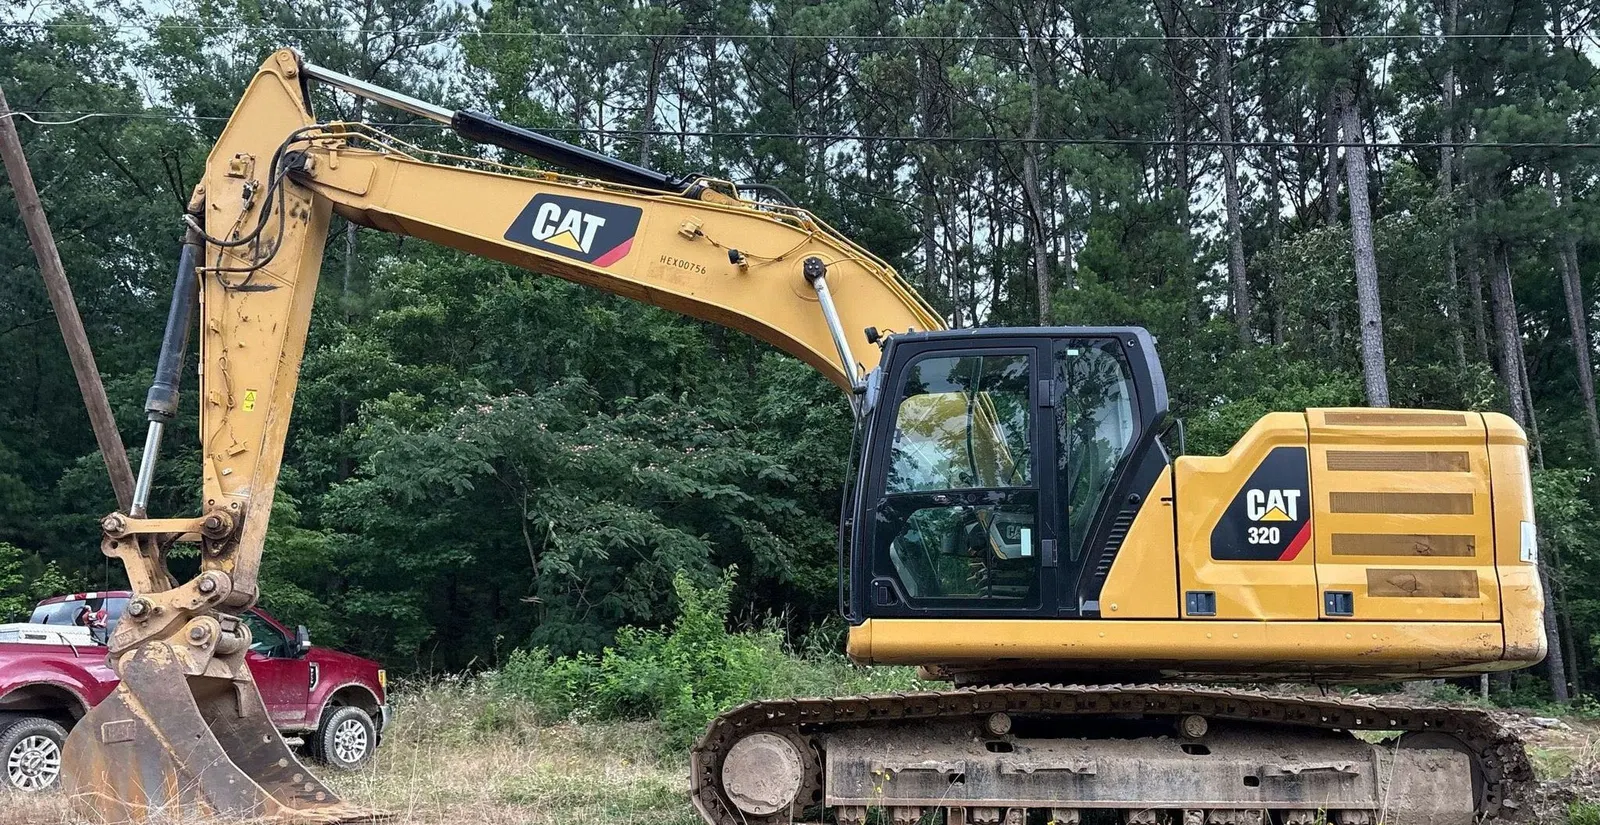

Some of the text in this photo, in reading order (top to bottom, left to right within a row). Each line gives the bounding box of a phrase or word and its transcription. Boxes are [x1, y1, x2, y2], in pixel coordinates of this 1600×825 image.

[531, 202, 606, 254] CAT
[660, 255, 706, 275] HEX00756
[1246, 489, 1300, 522] CAT
[1006, 525, 1023, 540] CA
[1248, 527, 1280, 544] 320
